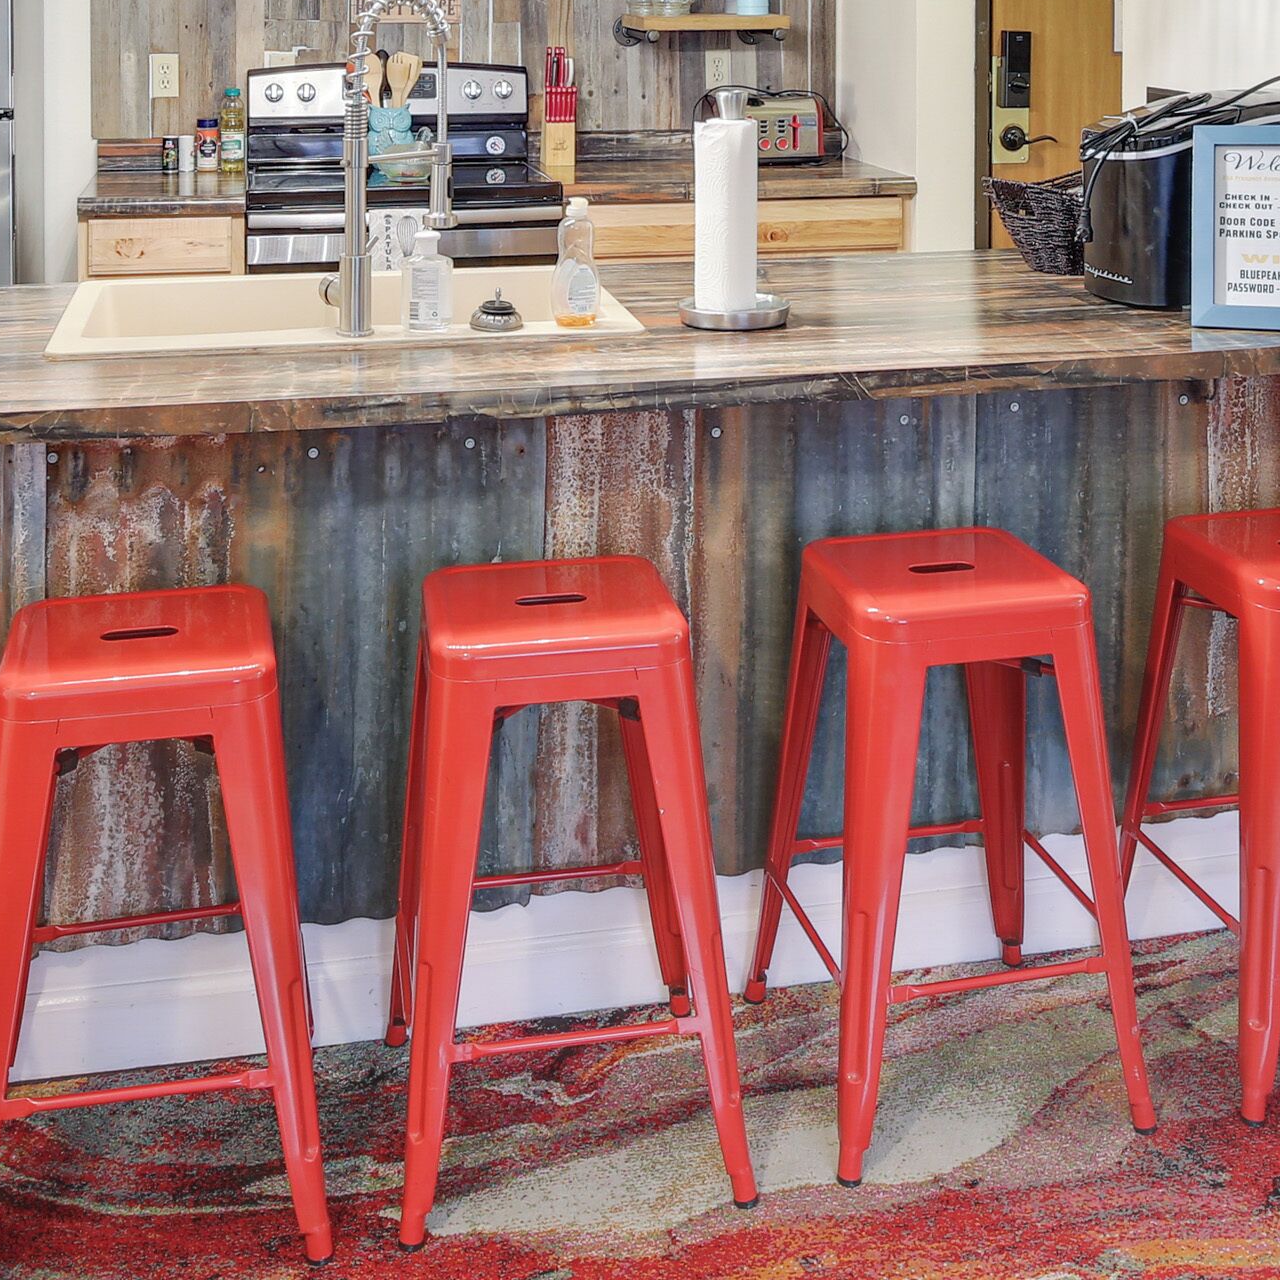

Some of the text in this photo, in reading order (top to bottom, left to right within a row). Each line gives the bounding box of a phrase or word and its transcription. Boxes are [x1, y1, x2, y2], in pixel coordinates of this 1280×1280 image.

[1224, 193, 1256, 201] CHECK
[1219, 216, 1246, 226] DOOR
[1250, 217, 1276, 227] CODE
[1219, 228, 1262, 239] PARKING
[1227, 282, 1274, 293] PASSWORD
